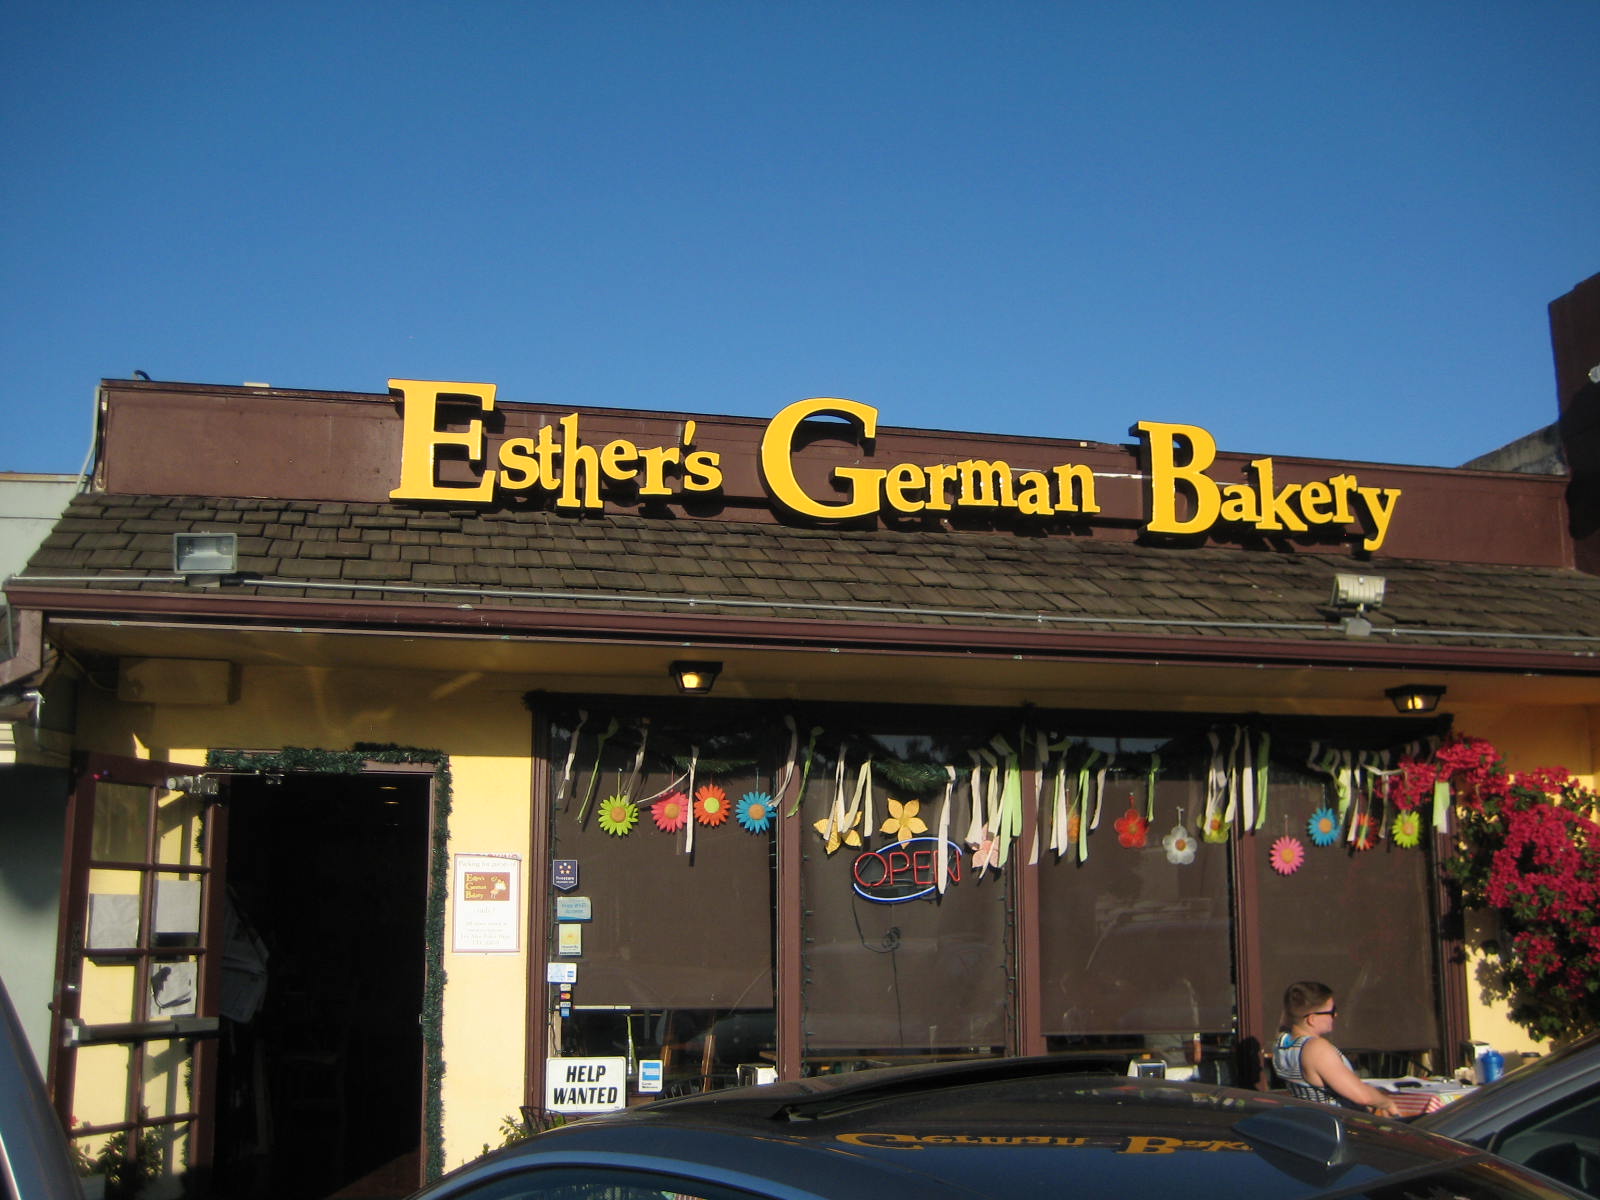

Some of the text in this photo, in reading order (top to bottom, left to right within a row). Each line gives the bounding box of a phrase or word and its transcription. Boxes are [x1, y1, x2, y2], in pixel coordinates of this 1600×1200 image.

[387, 378, 1401, 551] Esther's German Bakery
[854, 849, 961, 887] OPEN
[566, 1065, 606, 1083] HELP
[553, 1086, 618, 1105] WANTED
